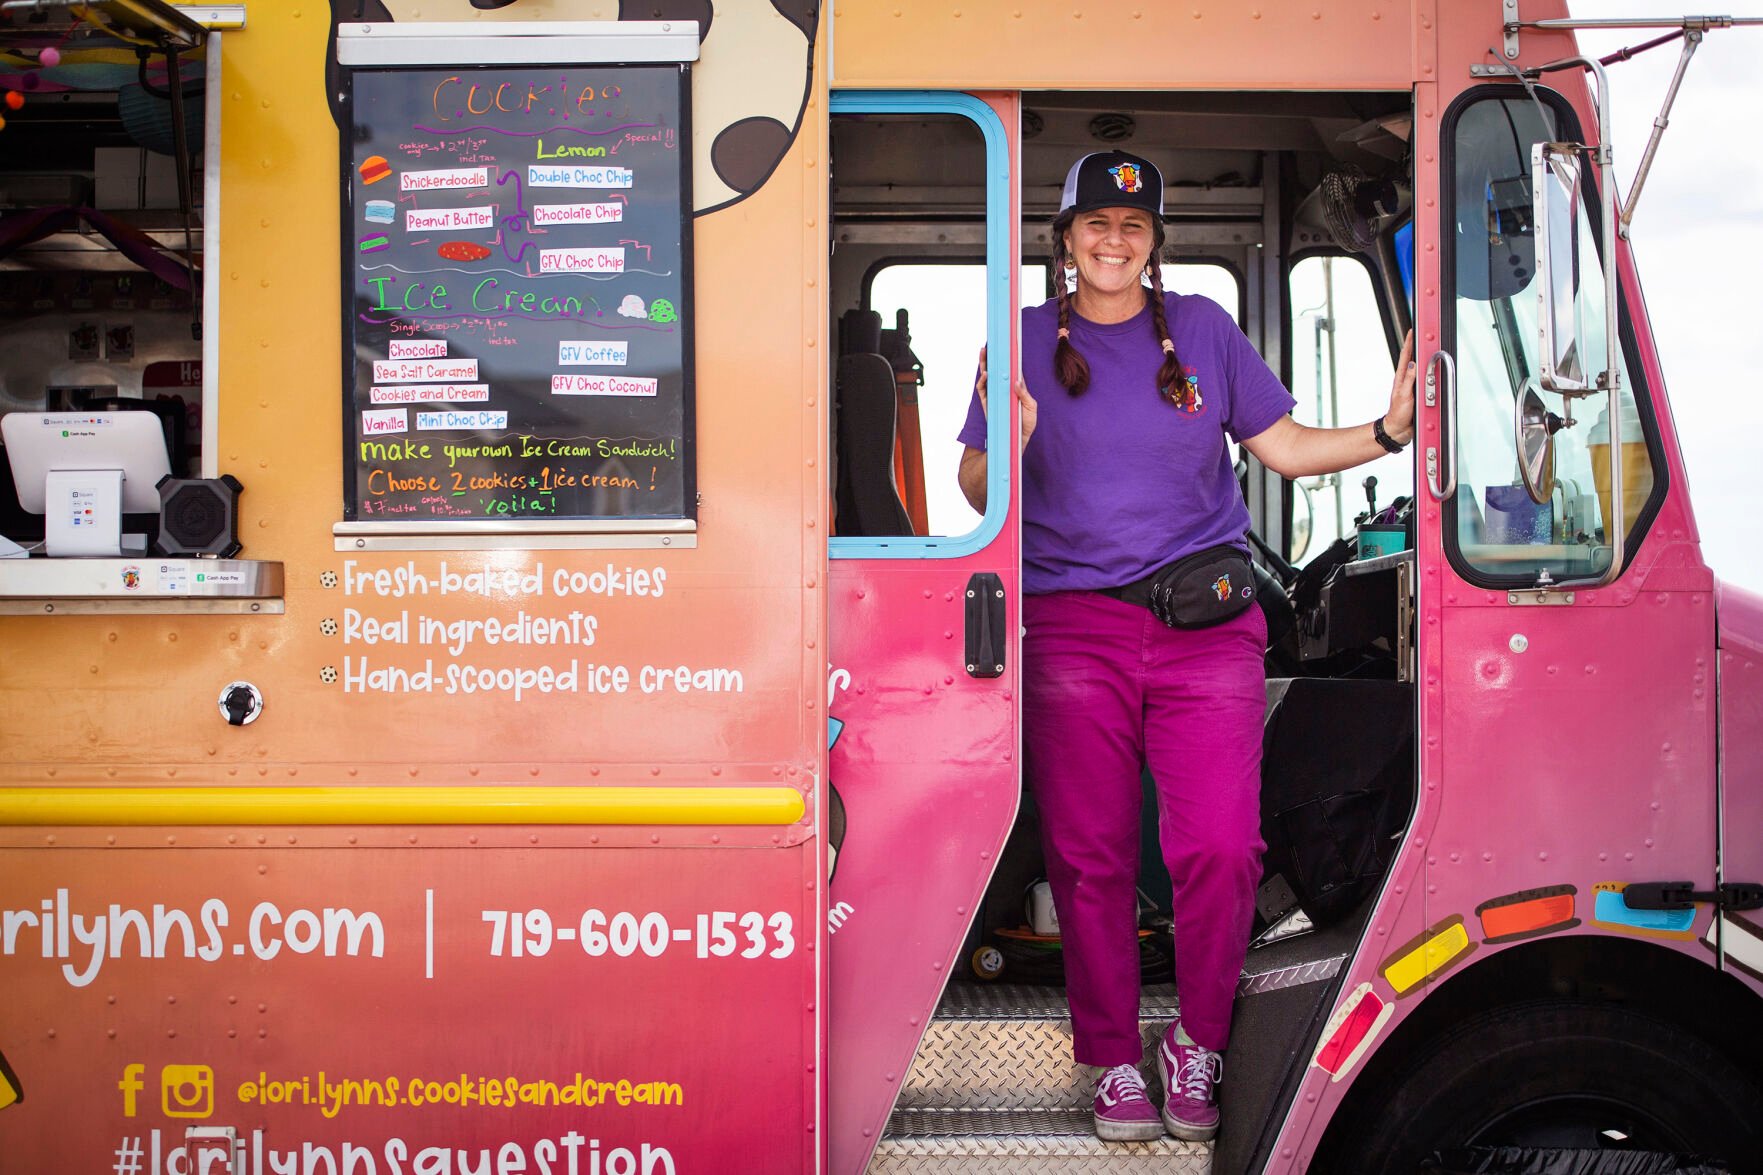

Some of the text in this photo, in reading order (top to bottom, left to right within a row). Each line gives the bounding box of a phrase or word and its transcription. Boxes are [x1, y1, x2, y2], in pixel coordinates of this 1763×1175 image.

[433, 76, 629, 121] Cookies
[536, 139, 606, 159] Lemon
[403, 173, 485, 189] Snickerdoodle
[529, 169, 632, 185] Double Choc Chip
[408, 212, 492, 229] Peanut Butter
[534, 206, 622, 222] Chocolate Chip
[541, 254, 562, 268] GFV
[565, 254, 594, 268] Choc
[597, 254, 624, 271] Chip
[362, 276, 603, 317] Ice Cream
[389, 319, 420, 336] Single
[390, 343, 447, 357] Chocolate
[560, 347, 626, 361] GFV Coffee
[376, 365, 476, 379] Sea Salt Caramel
[552, 376, 656, 393] GFV Choc Coconut
[373, 386, 487, 401] Cookies and Cream
[364, 412, 505, 432] Vanilla Mint Choc Chip
[518, 435, 543, 458] Ice
[547, 440, 591, 457] Cream
[596, 439, 675, 460] Sandwich!
[367, 469, 441, 496] Choose
[581, 473, 640, 490] cream
[344, 559, 667, 598] Fresh-baked cookies
[344, 608, 597, 656] Real ingredients
[344, 655, 743, 702] Hand-scooped ice cream
[482, 908, 795, 959] 719-600-1533
